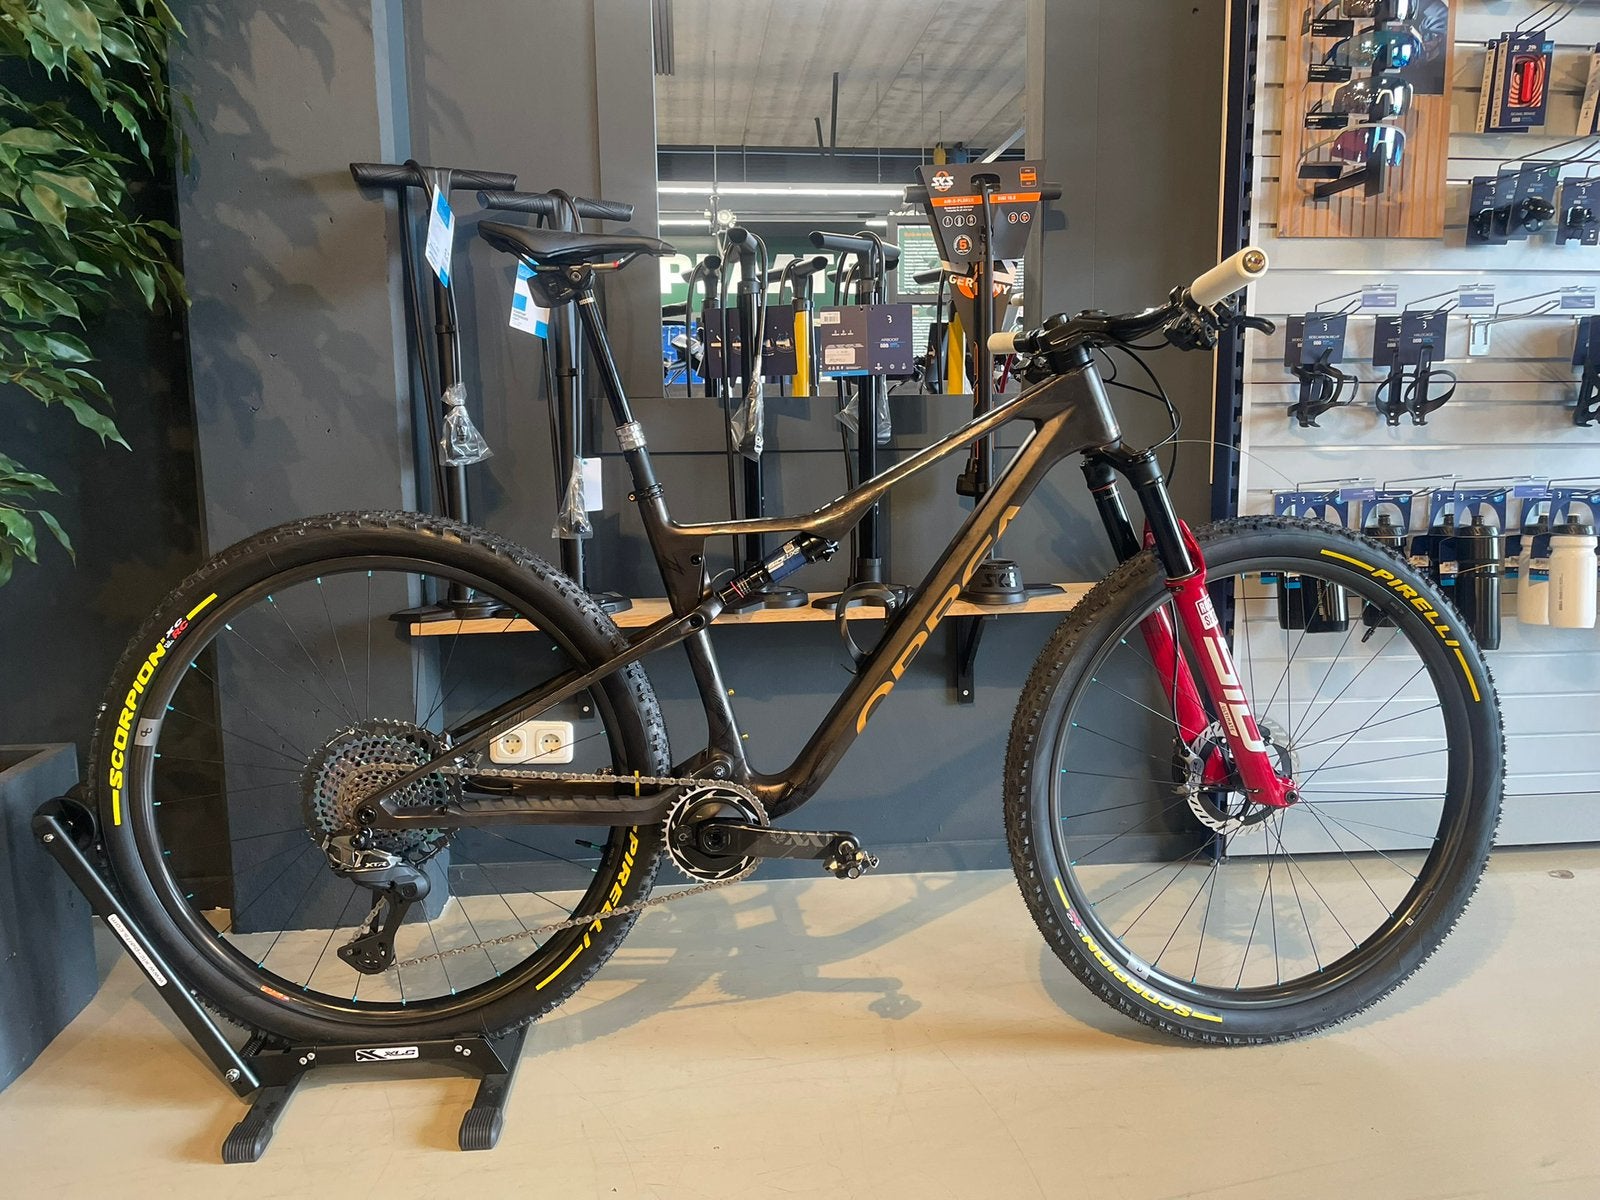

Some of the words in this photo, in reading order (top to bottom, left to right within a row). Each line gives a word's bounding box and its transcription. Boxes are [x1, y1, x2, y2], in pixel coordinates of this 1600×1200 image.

[931, 176, 954, 187] SKS
[949, 274, 1011, 295] GERNY
[1371, 568, 1461, 647] PIRELLI
[109, 640, 168, 790] SCORPION
[583, 830, 640, 949] PIRELLI
[109, 914, 165, 984] www.xlc-parts.com
[1081, 935, 1193, 1018] SCORPION
